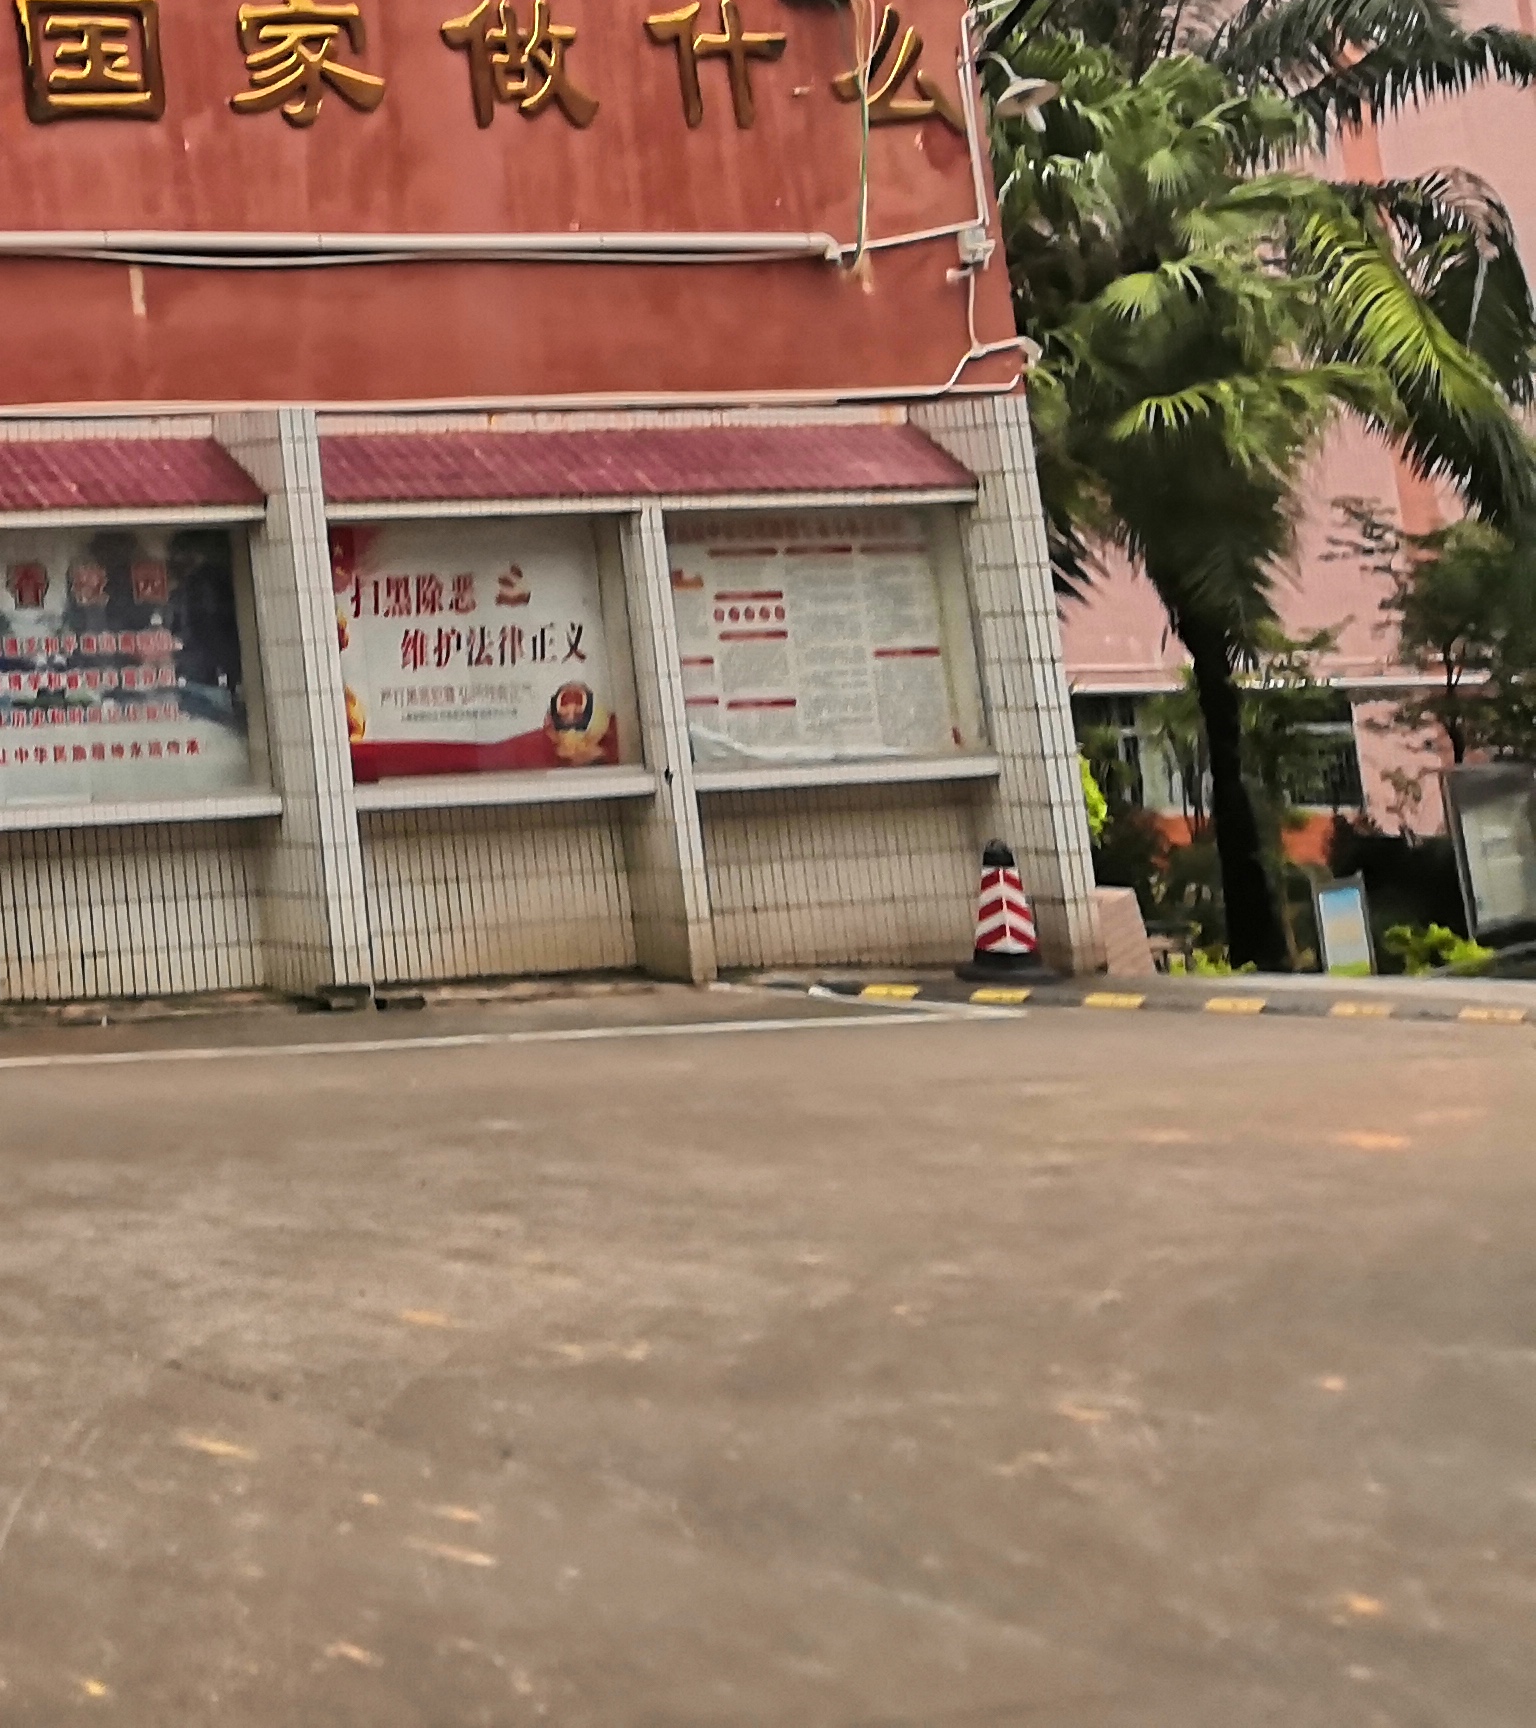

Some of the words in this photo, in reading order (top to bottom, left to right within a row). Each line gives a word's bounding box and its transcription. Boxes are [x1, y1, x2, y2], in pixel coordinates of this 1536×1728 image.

[350, 573, 478, 619] 扫黑除恶
[400, 622, 588, 671] 维护法律正义
